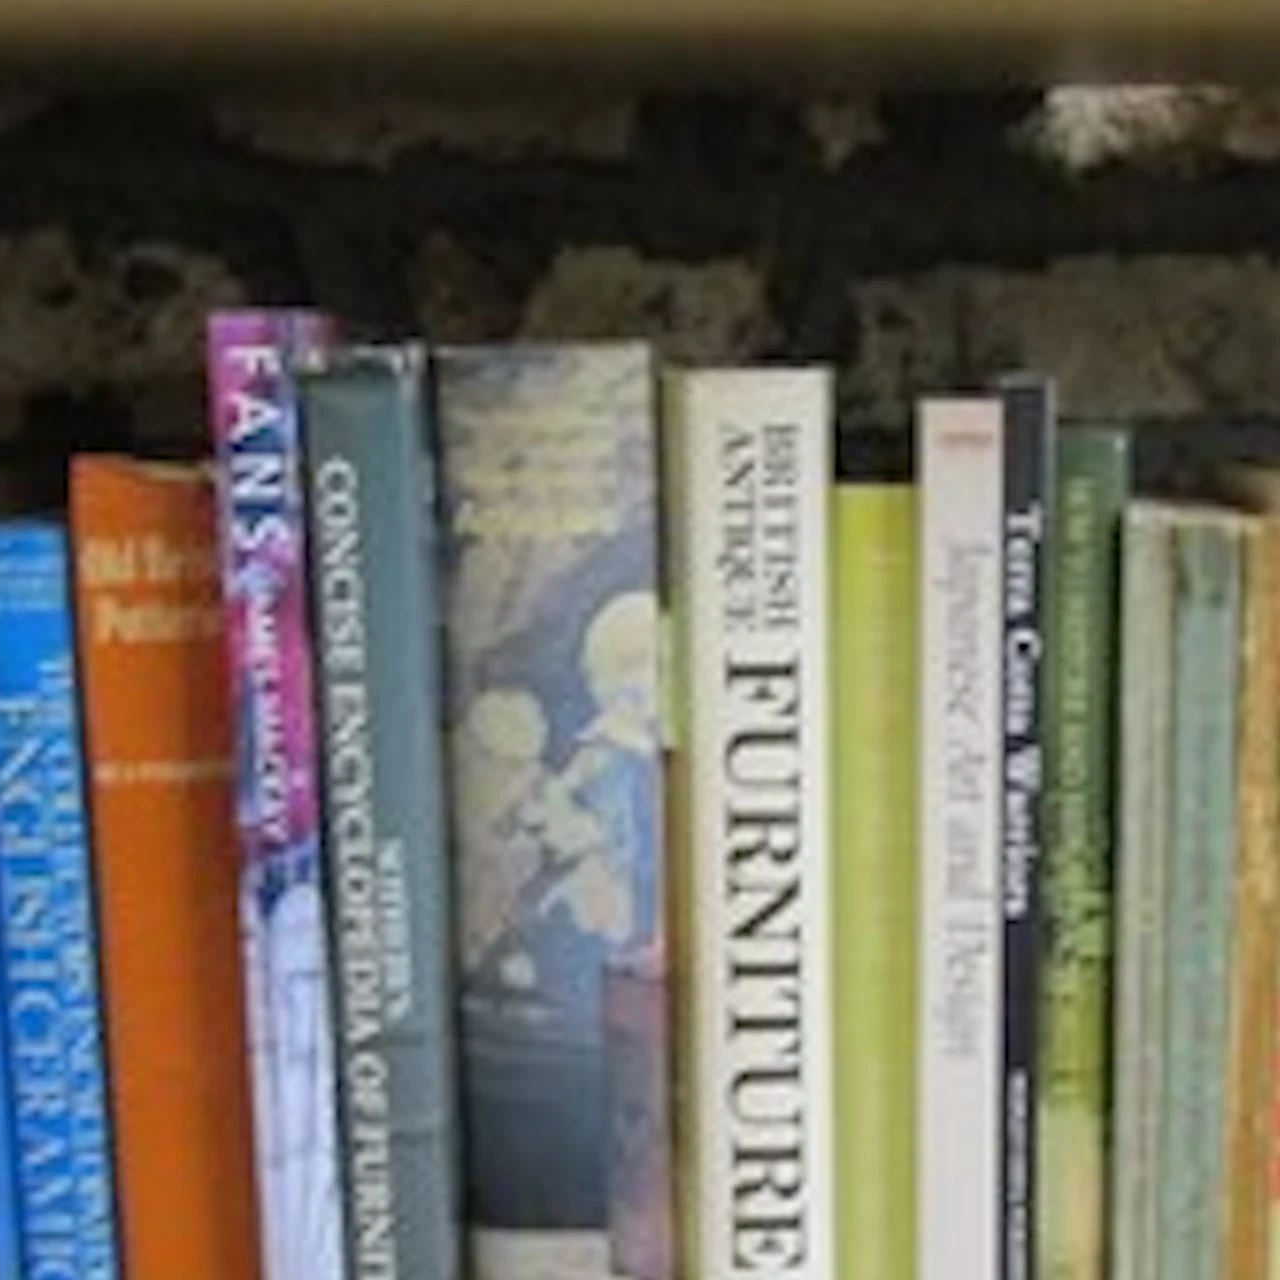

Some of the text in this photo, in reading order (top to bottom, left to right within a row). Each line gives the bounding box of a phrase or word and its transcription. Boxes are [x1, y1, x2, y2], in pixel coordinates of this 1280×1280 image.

[221, 341, 288, 553] FANS
[317, 461, 367, 666] CONCISE
[328, 685, 382, 1041] ENCYCLOPEDIA
[723, 659, 806, 1271] FURNITURE
[347, 1054, 388, 1112] OF
